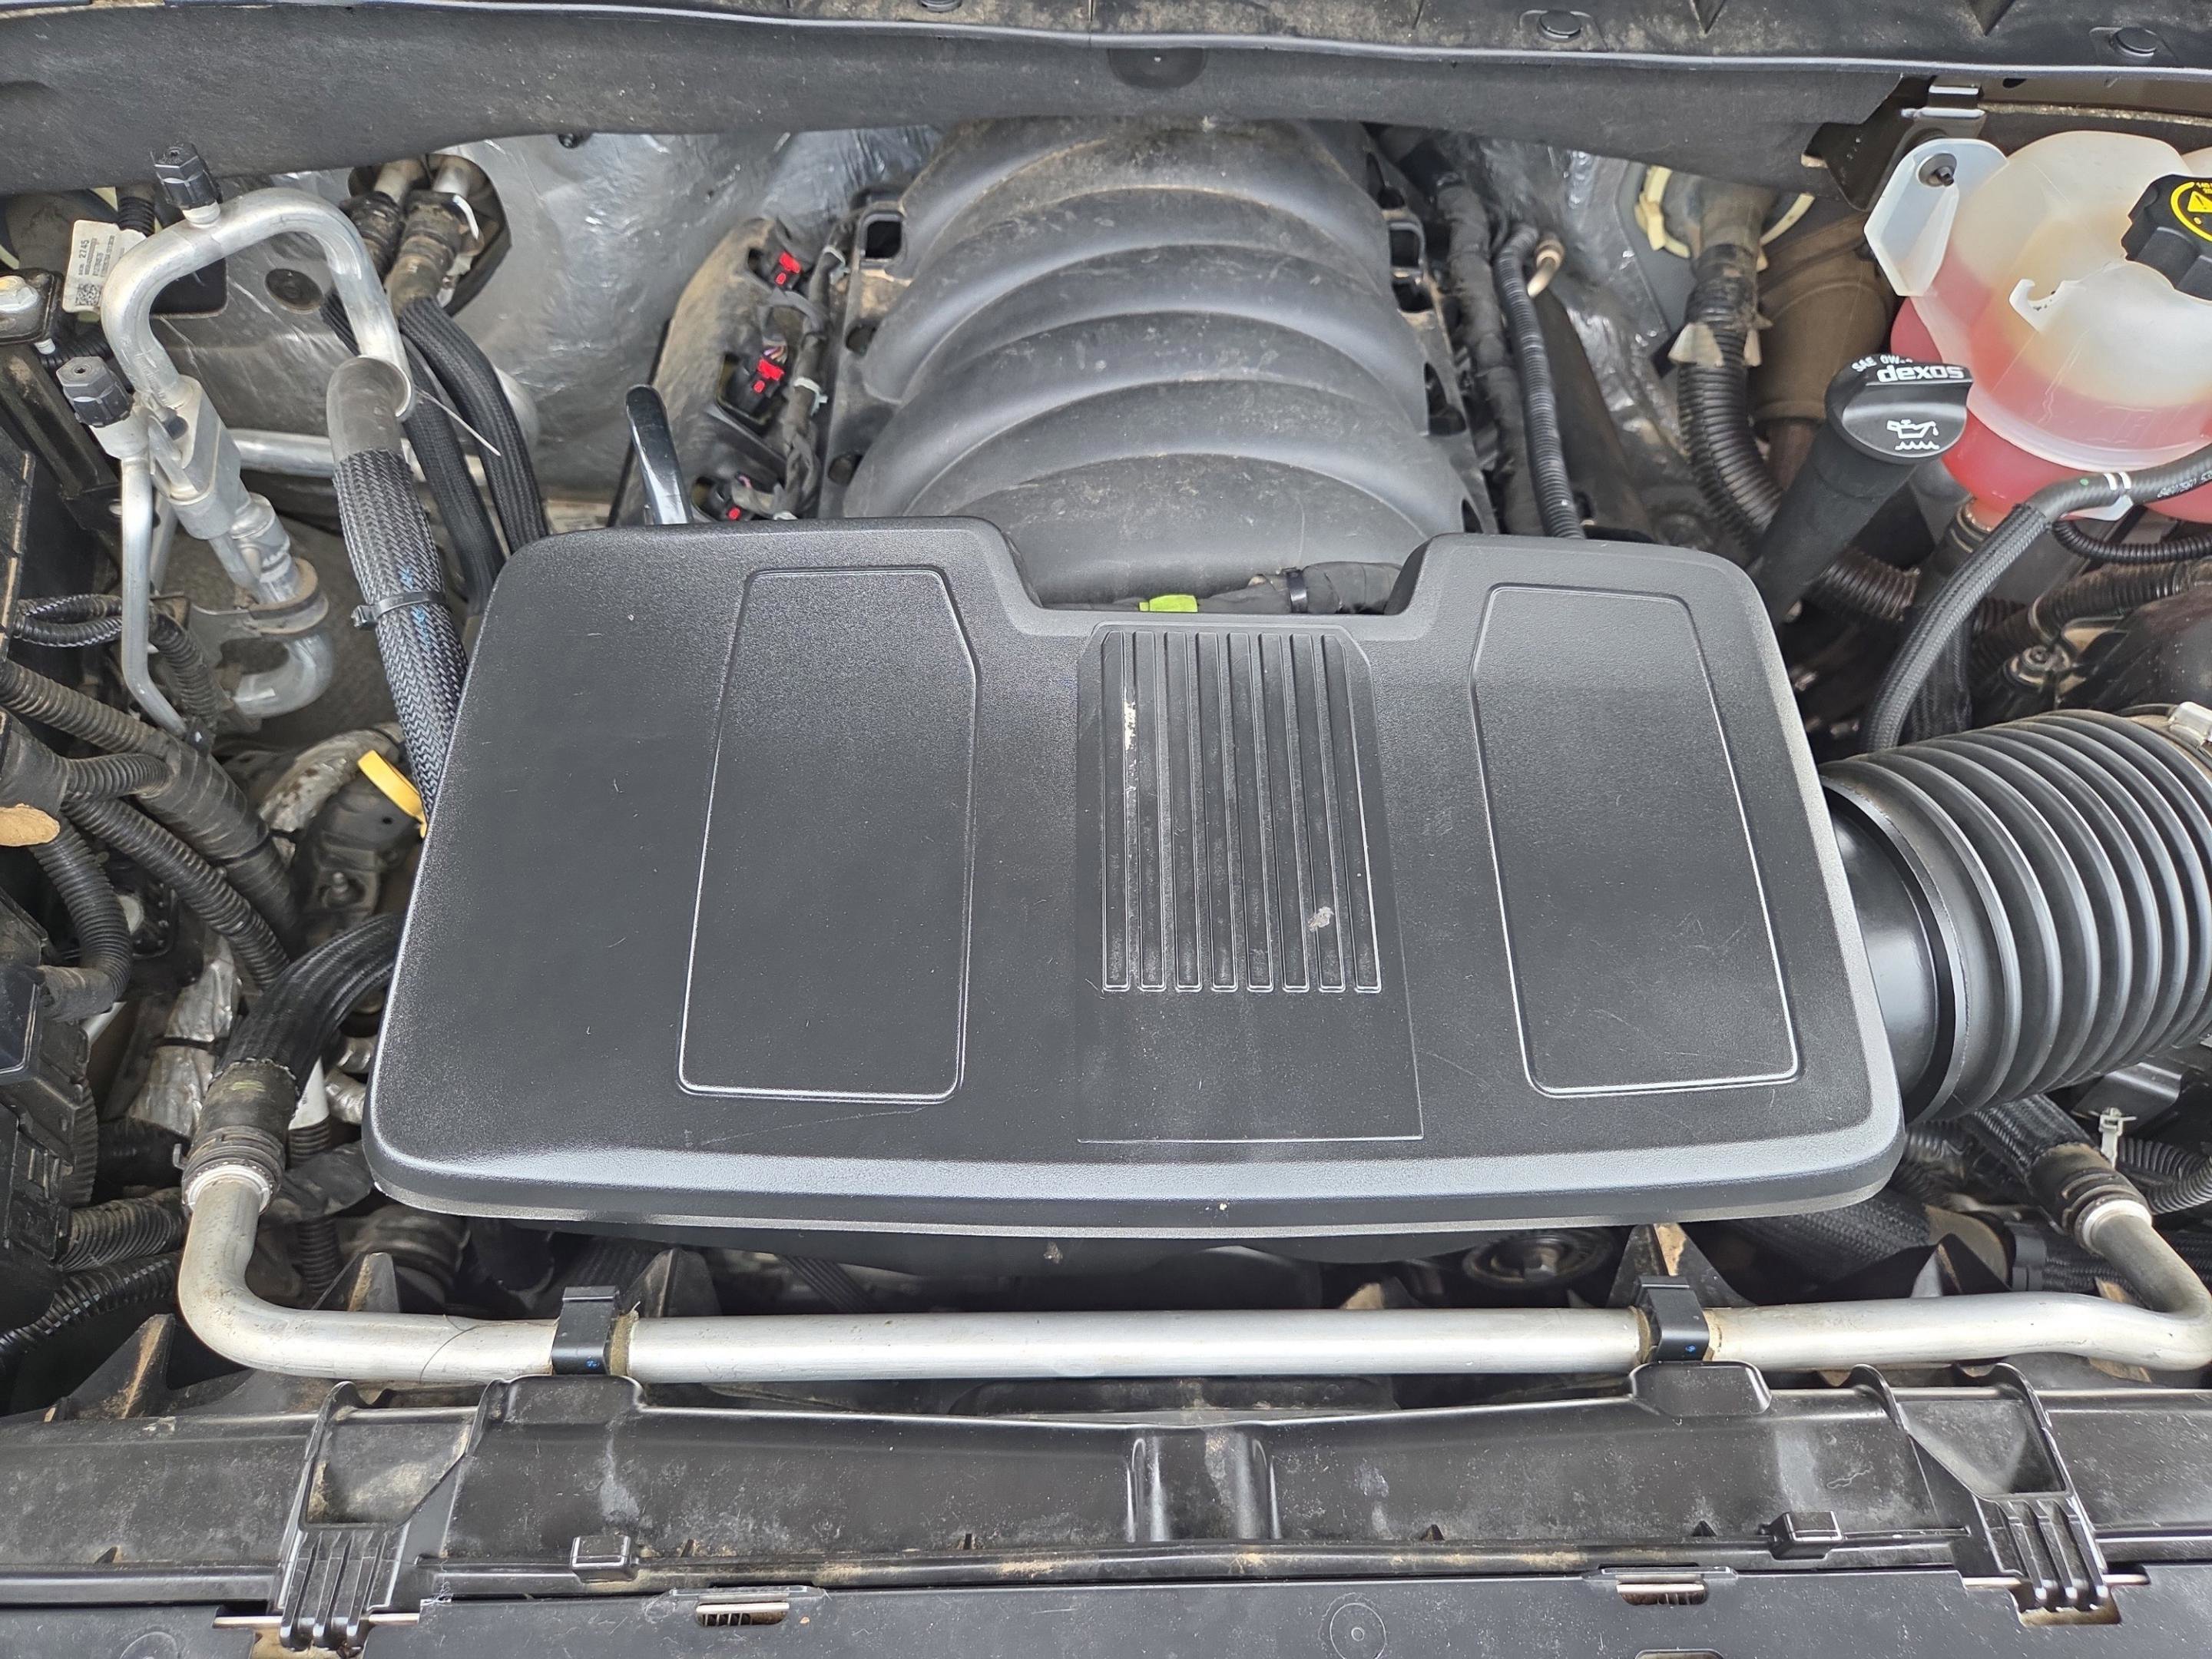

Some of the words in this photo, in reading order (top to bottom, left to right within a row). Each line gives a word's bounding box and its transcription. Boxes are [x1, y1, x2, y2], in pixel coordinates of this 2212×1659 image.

[78, 240, 90, 259] 2745
[1851, 356, 1877, 373] SAE
[1876, 364, 1965, 382] dexos
